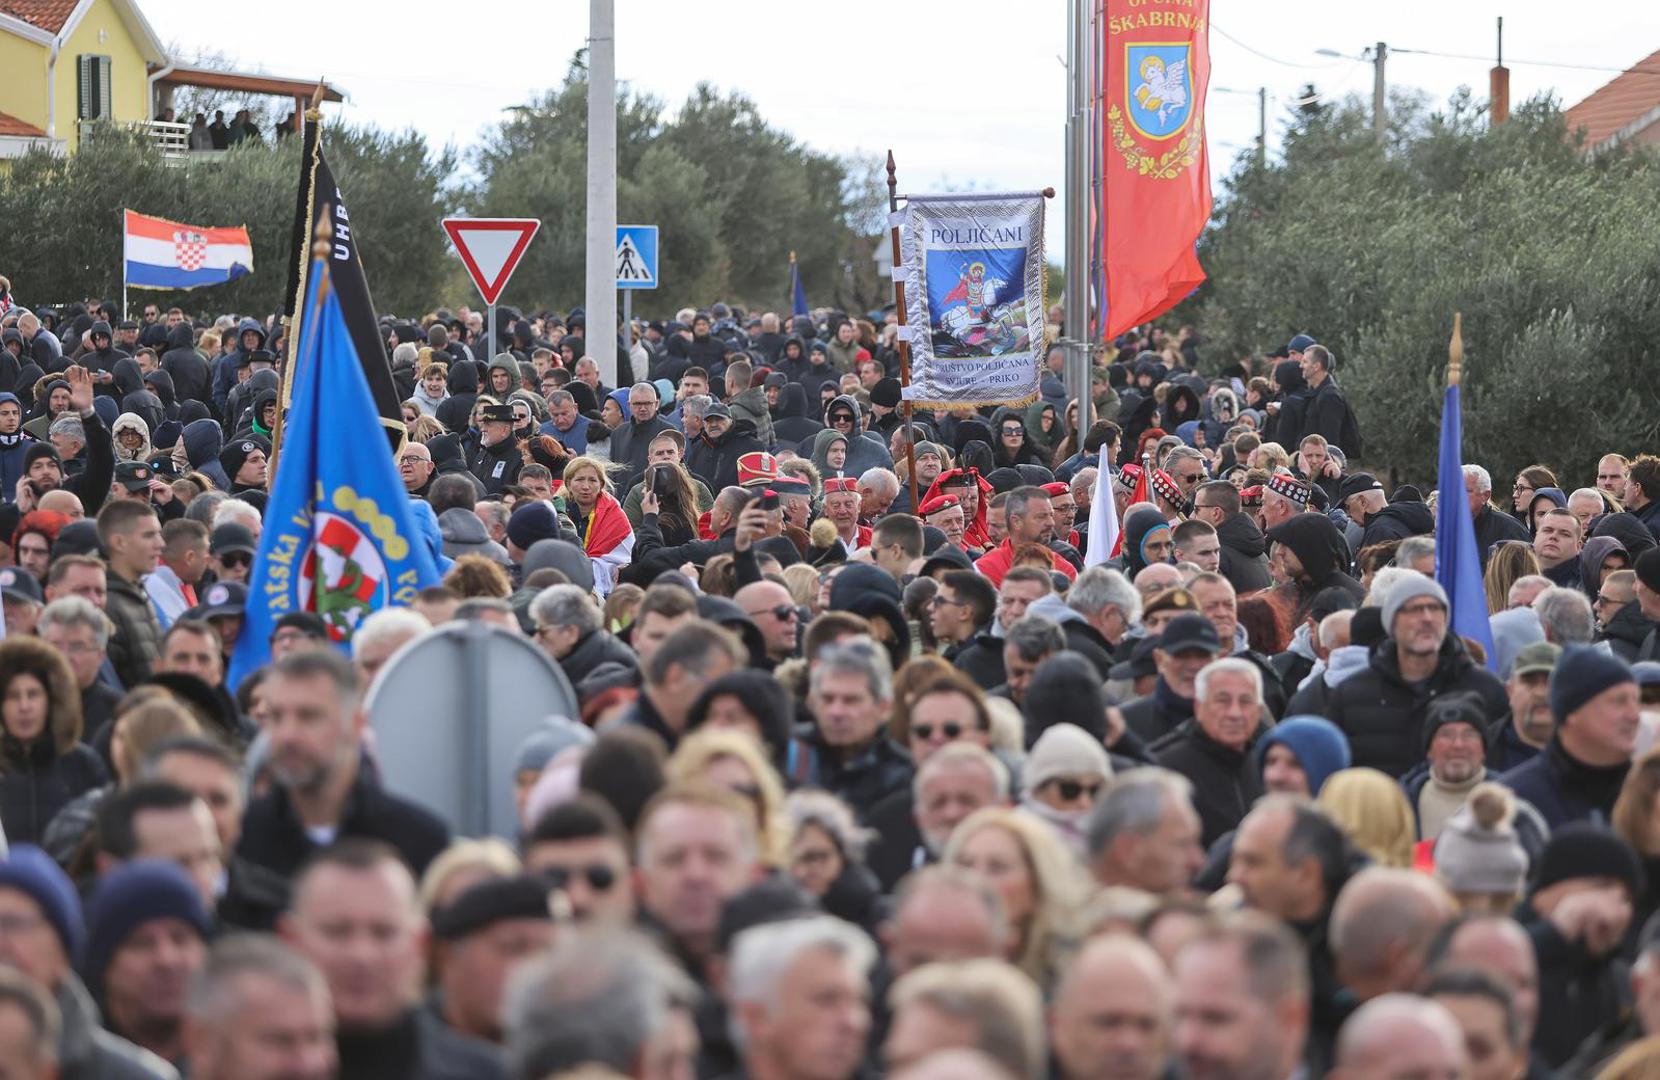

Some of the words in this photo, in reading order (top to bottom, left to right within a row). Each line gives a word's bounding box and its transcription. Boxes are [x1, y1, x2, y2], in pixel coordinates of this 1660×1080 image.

[334, 187, 350, 261] UHB
[931, 223, 1023, 244] POLJIČANI
[976, 358, 1030, 371] POLJIČANA
[989, 373, 1020, 384] PRIKO
